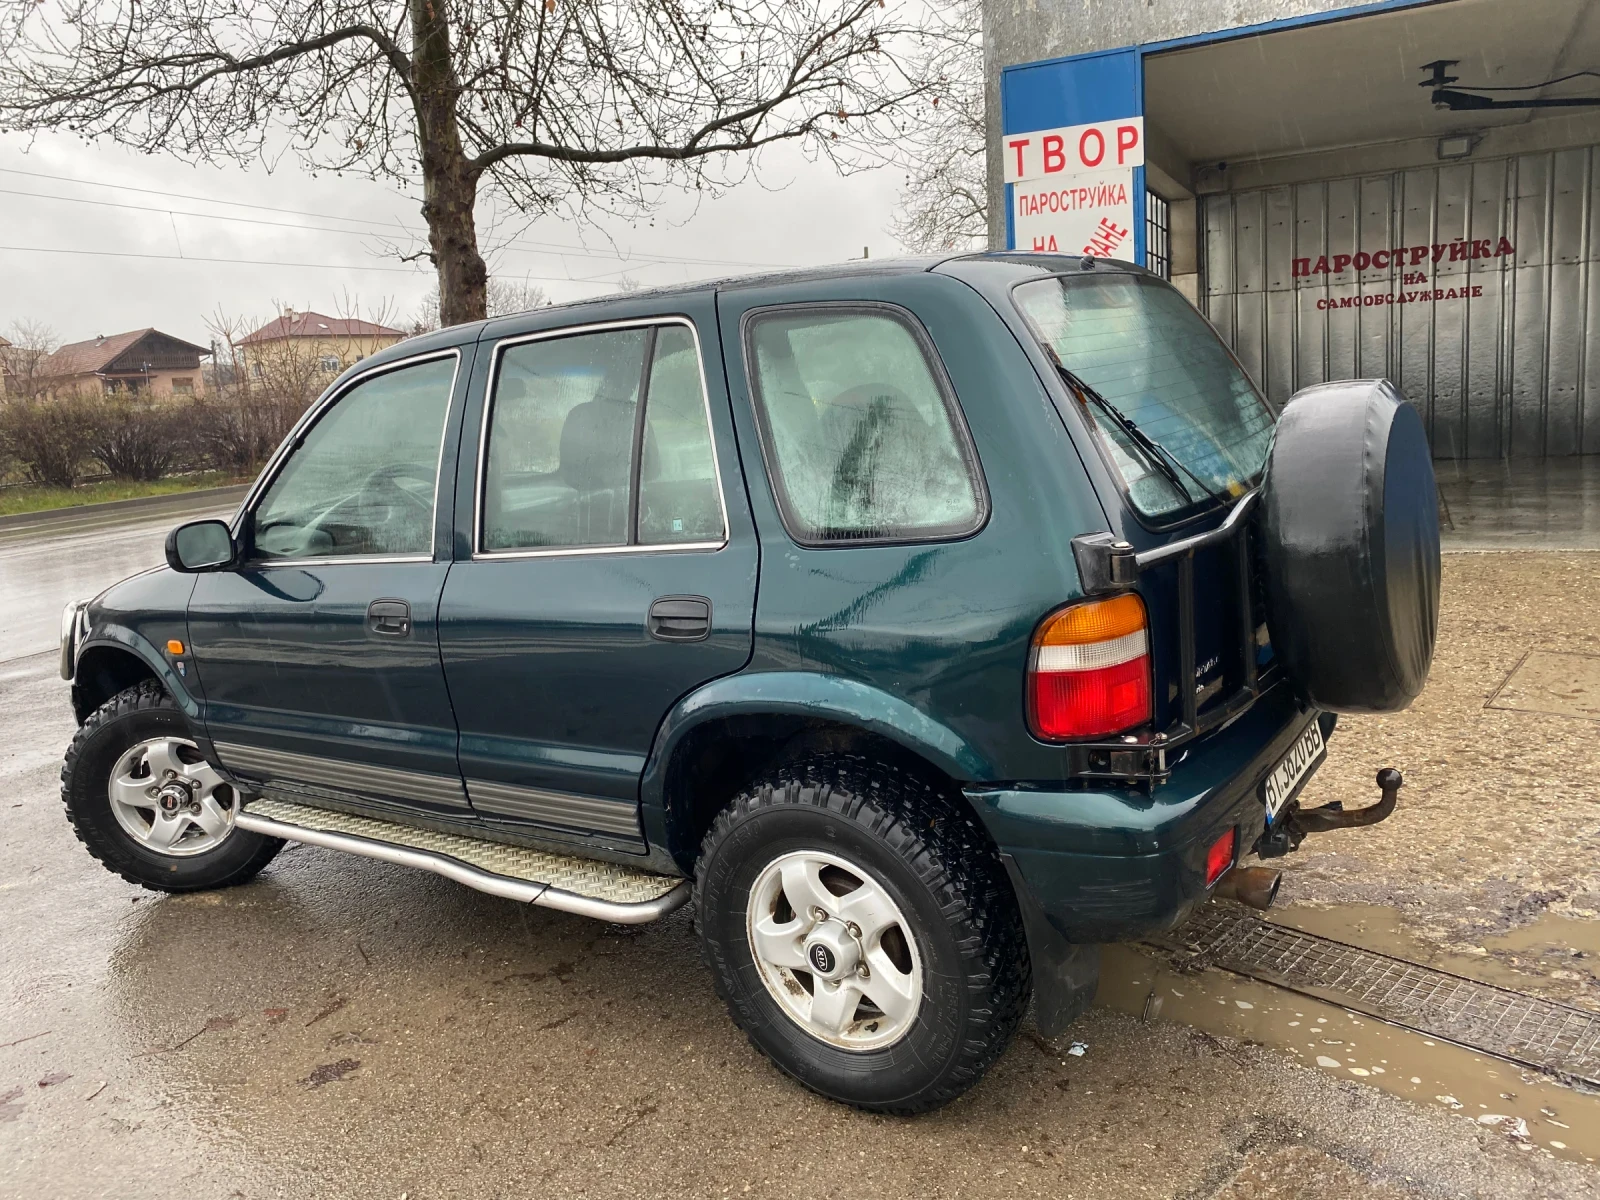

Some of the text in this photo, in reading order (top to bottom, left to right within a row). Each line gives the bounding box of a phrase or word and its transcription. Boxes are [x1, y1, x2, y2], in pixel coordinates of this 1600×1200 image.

[1009, 125, 1139, 177] ТВОР
[1019, 180, 1128, 217] ПАРОСТРУЙКА
[1033, 234, 1059, 252] НА
[1291, 236, 1514, 277] ПАРОСТРУЙКА
[1403, 272, 1428, 285] НА
[1316, 285, 1483, 311] САМООБСЛУЖВАНЕ
[817, 949, 827, 968] KIA
